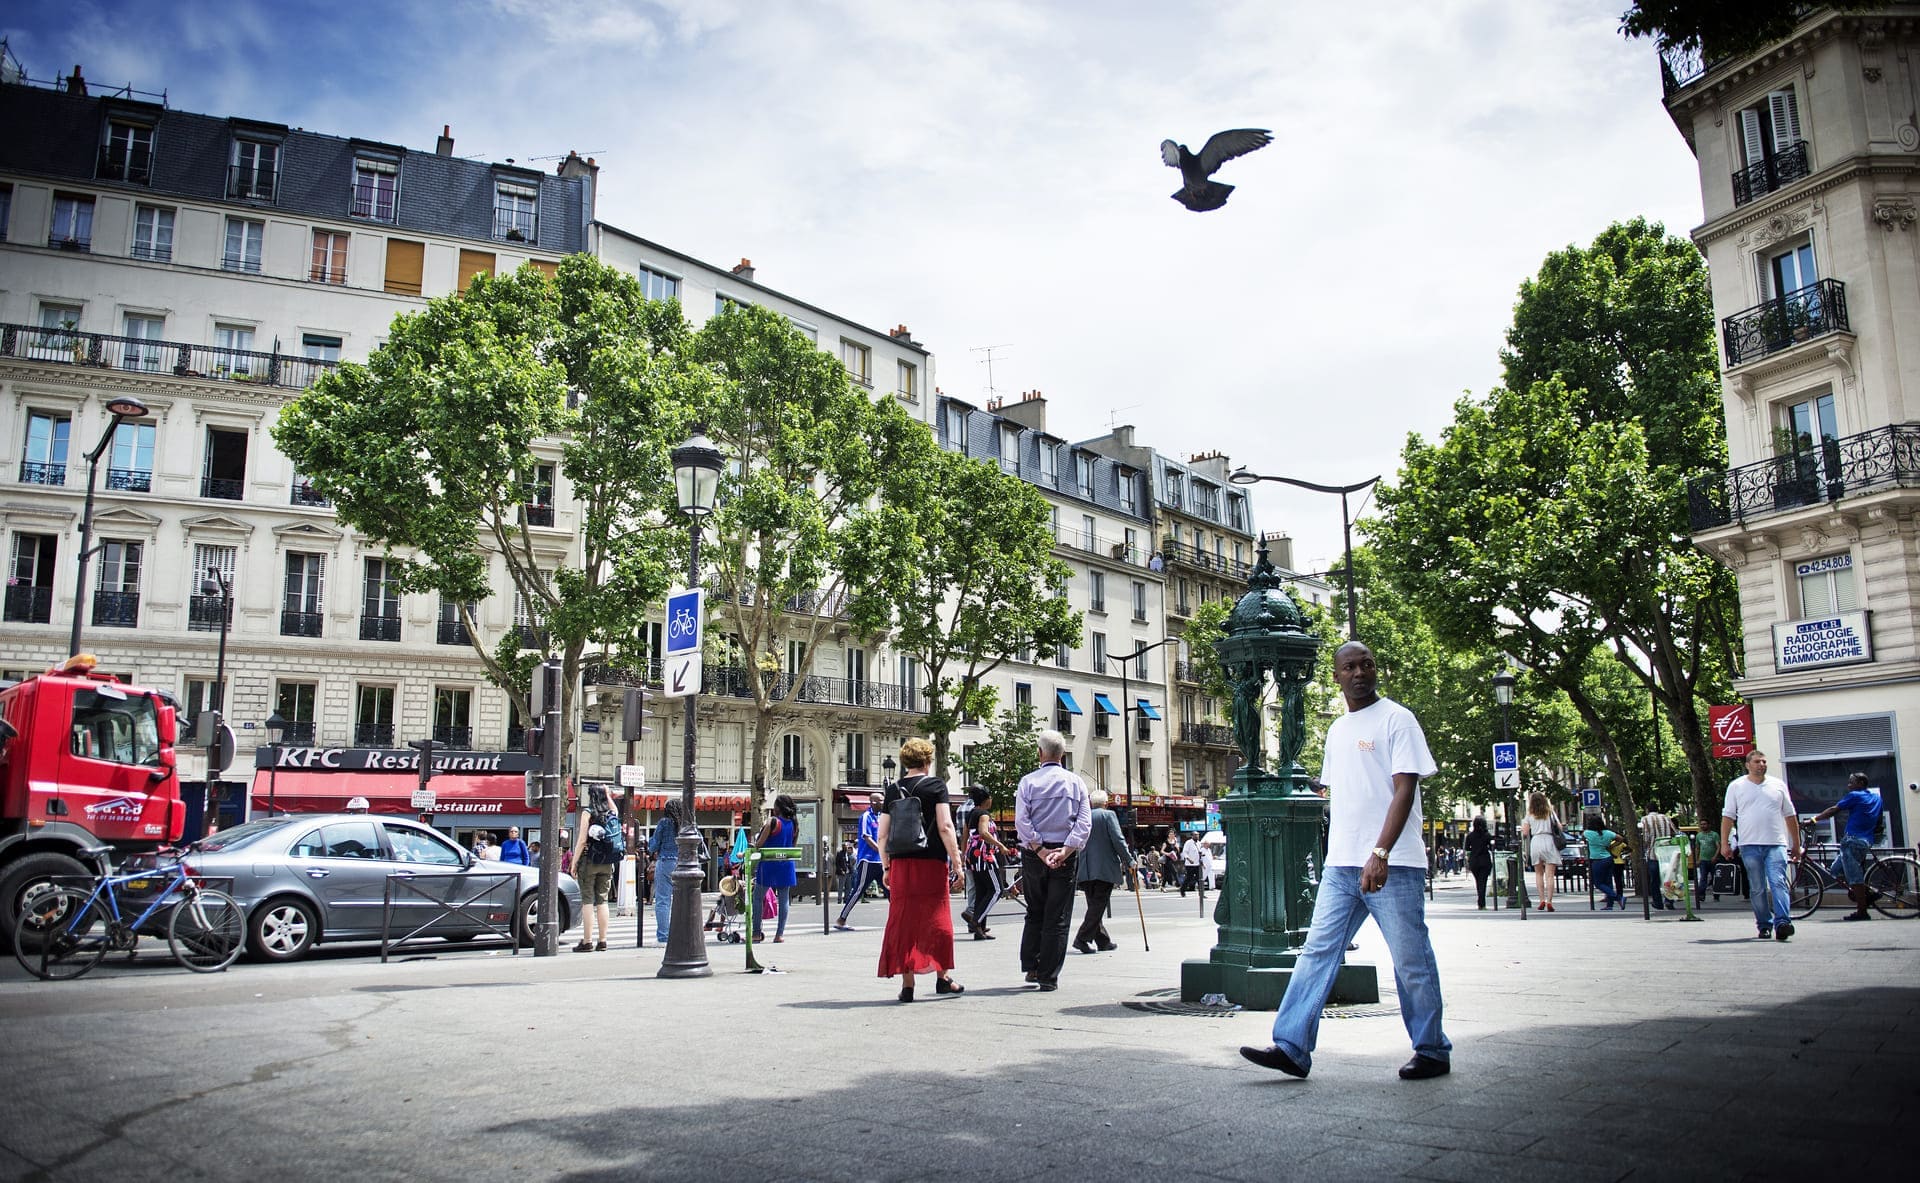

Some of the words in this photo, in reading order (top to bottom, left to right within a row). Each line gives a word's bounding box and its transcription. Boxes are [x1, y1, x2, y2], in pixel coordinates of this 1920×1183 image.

[1786, 627, 1854, 645] RADIOLOGIE
[1783, 636, 1860, 656] ECHOGRAPHIE
[1783, 646, 1863, 665] MAMMOGRAPHIE
[276, 747, 342, 768] KFC
[364, 751, 501, 771] Resturant
[694, 796, 752, 812] ASHION
[1587, 793, 1596, 804] P
